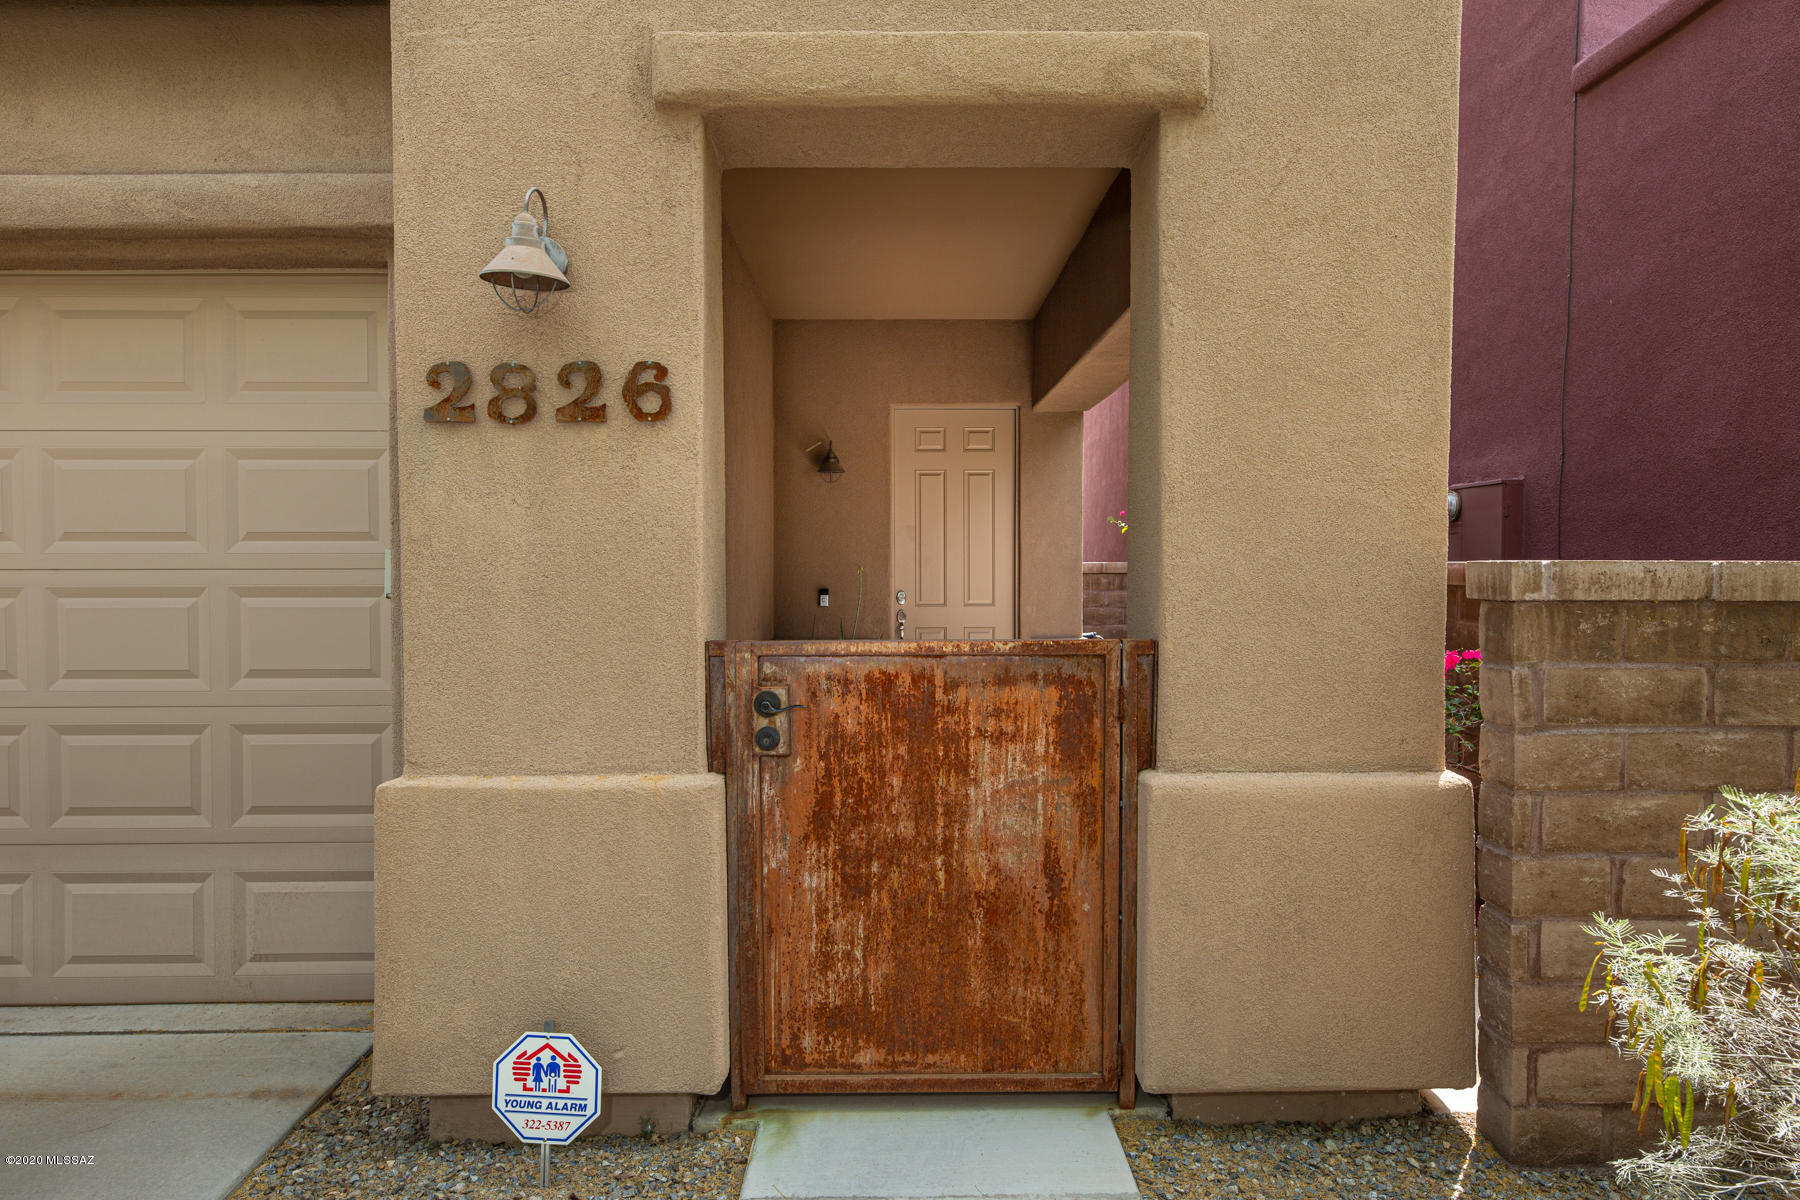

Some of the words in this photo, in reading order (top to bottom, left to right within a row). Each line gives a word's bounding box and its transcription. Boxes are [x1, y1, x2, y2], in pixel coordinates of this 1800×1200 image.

[423, 360, 672, 425] 2826
[504, 1098, 543, 1110] YOUNG
[545, 1101, 588, 1113] ALARM
[521, 1119, 571, 1131] 322-5387
